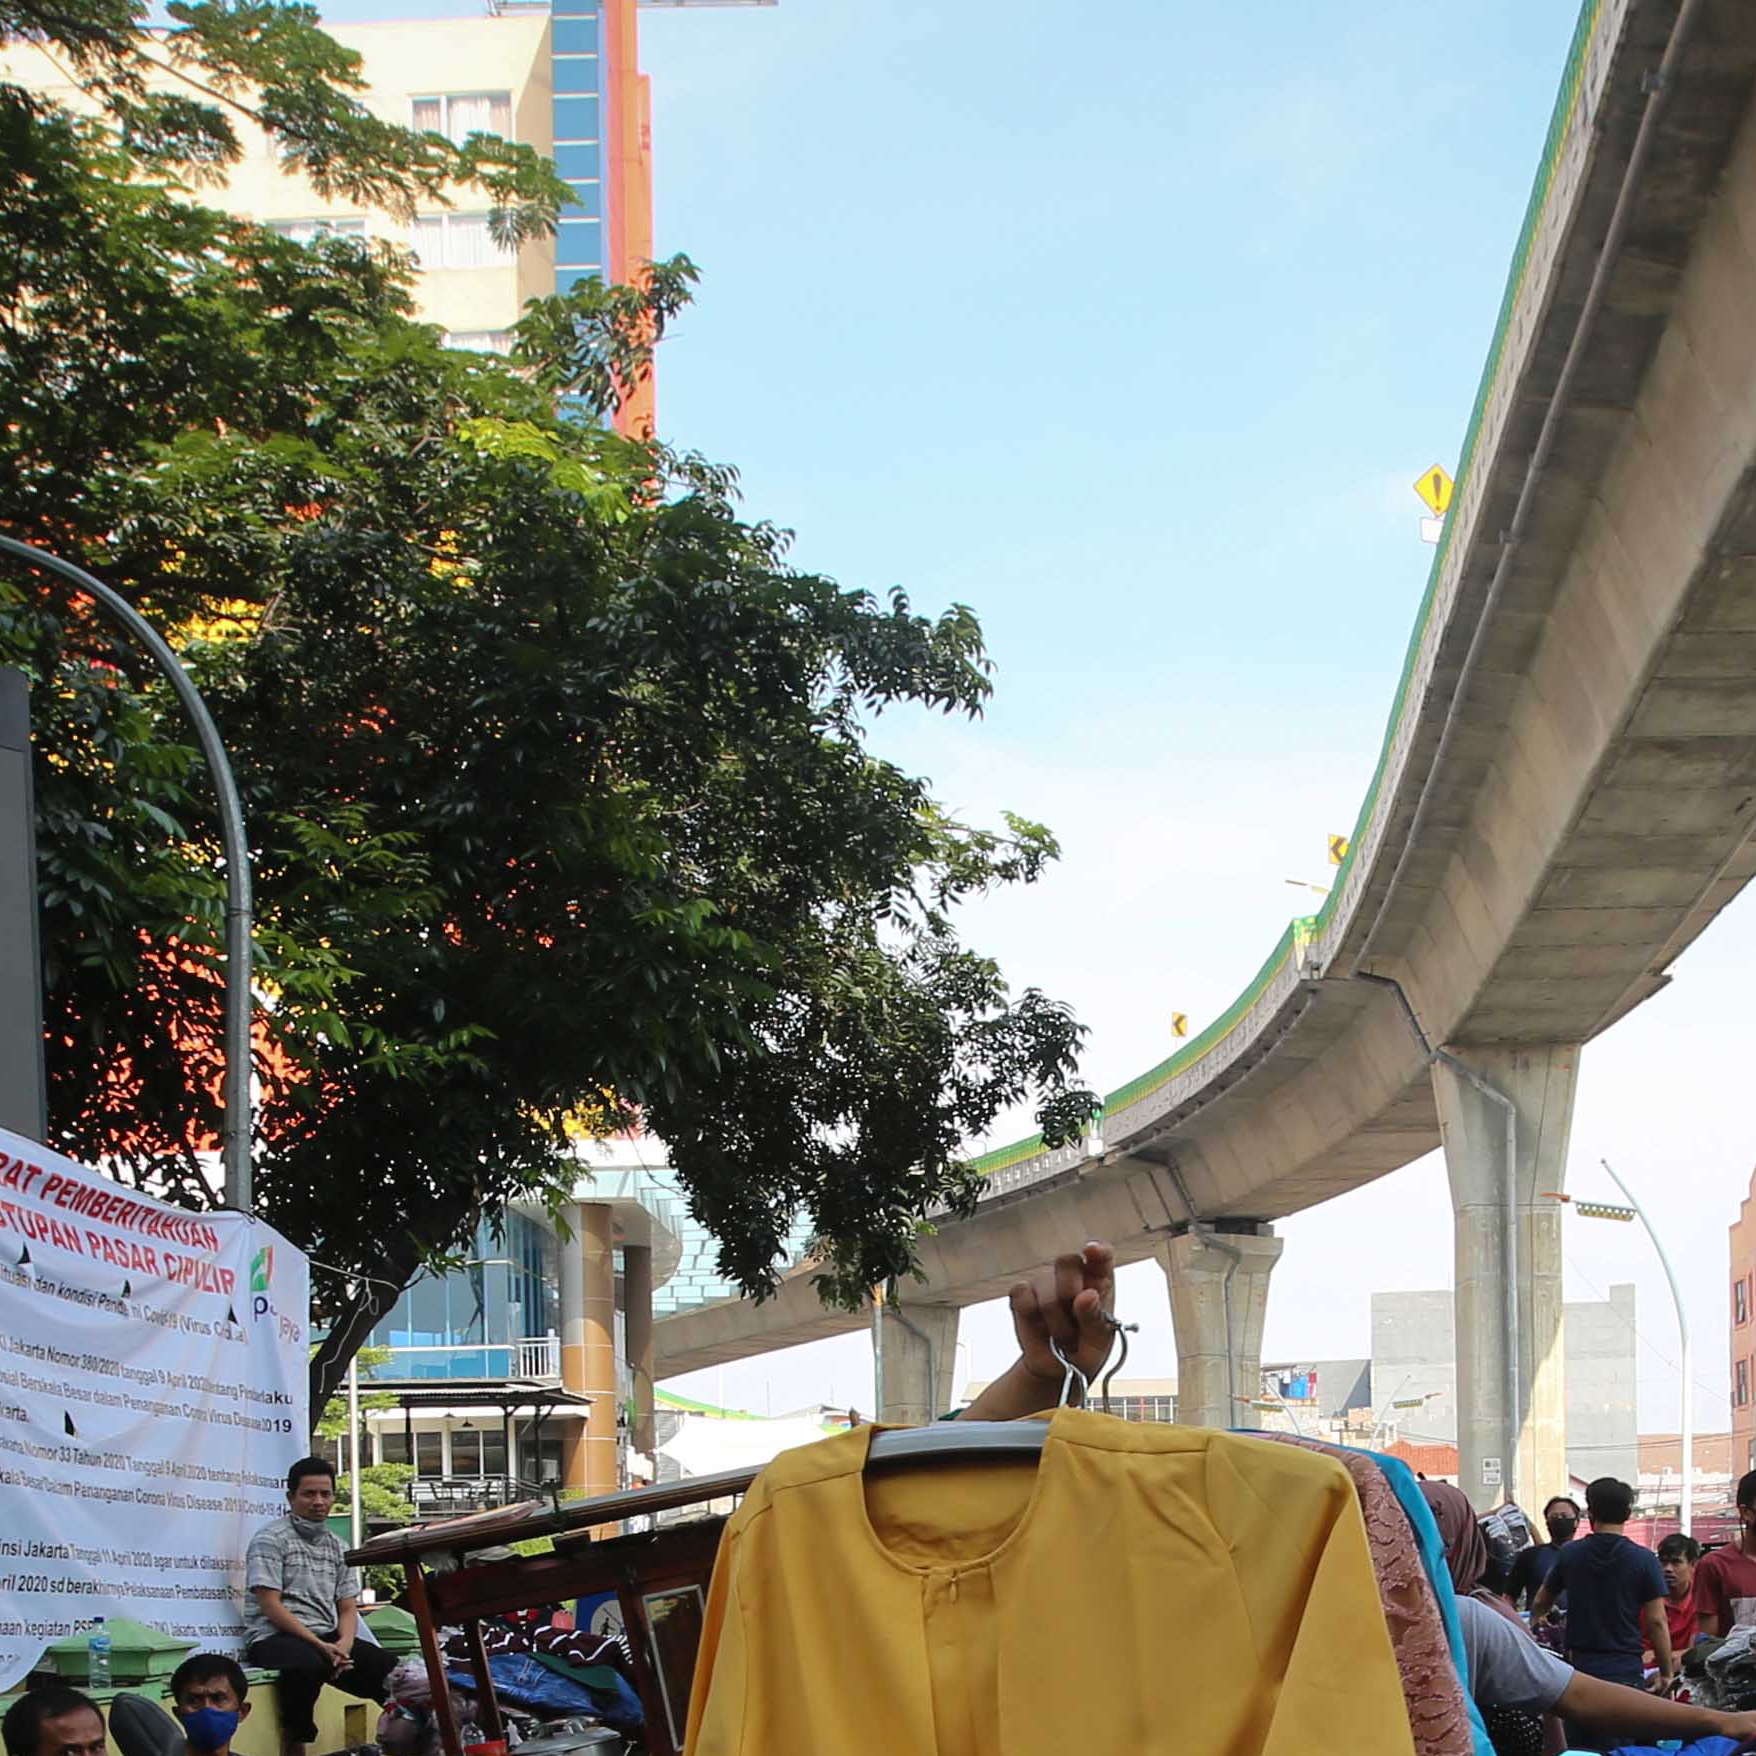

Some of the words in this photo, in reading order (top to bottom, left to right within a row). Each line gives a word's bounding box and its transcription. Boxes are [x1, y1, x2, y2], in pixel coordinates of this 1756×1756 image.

[39, 1173, 219, 1253] PEMBERITAHUAN
[85, 1228, 161, 1277] PASAR
[33, 1274, 55, 1296] dan
[57, 1280, 98, 1308] kondisi
[8, 1335, 46, 1361] Jakarta
[46, 1345, 80, 1369] Nomor
[121, 1362, 159, 1387] tanggal
[166, 1370, 187, 1389] April
[62, 1381, 93, 1402] Besar
[22, 1439, 58, 1462] Nomor
[58, 1446, 72, 1463] 33
[71, 1449, 103, 1468] Tahun
[103, 1453, 126, 1472] 2020
[125, 1454, 165, 1479] Tanggal
[73, 1482, 135, 1504] Penanganan
[23, 1540, 70, 1560] Jakarta
[109, 1551, 132, 1569] April
[132, 1552, 153, 1568] 2020
[152, 1555, 173, 1572] agar
[173, 1555, 198, 1570] untuk
[17, 1575, 47, 1593] 2020
[49, 1577, 66, 1594] sd
[23, 1618, 71, 1641] kegiatan
